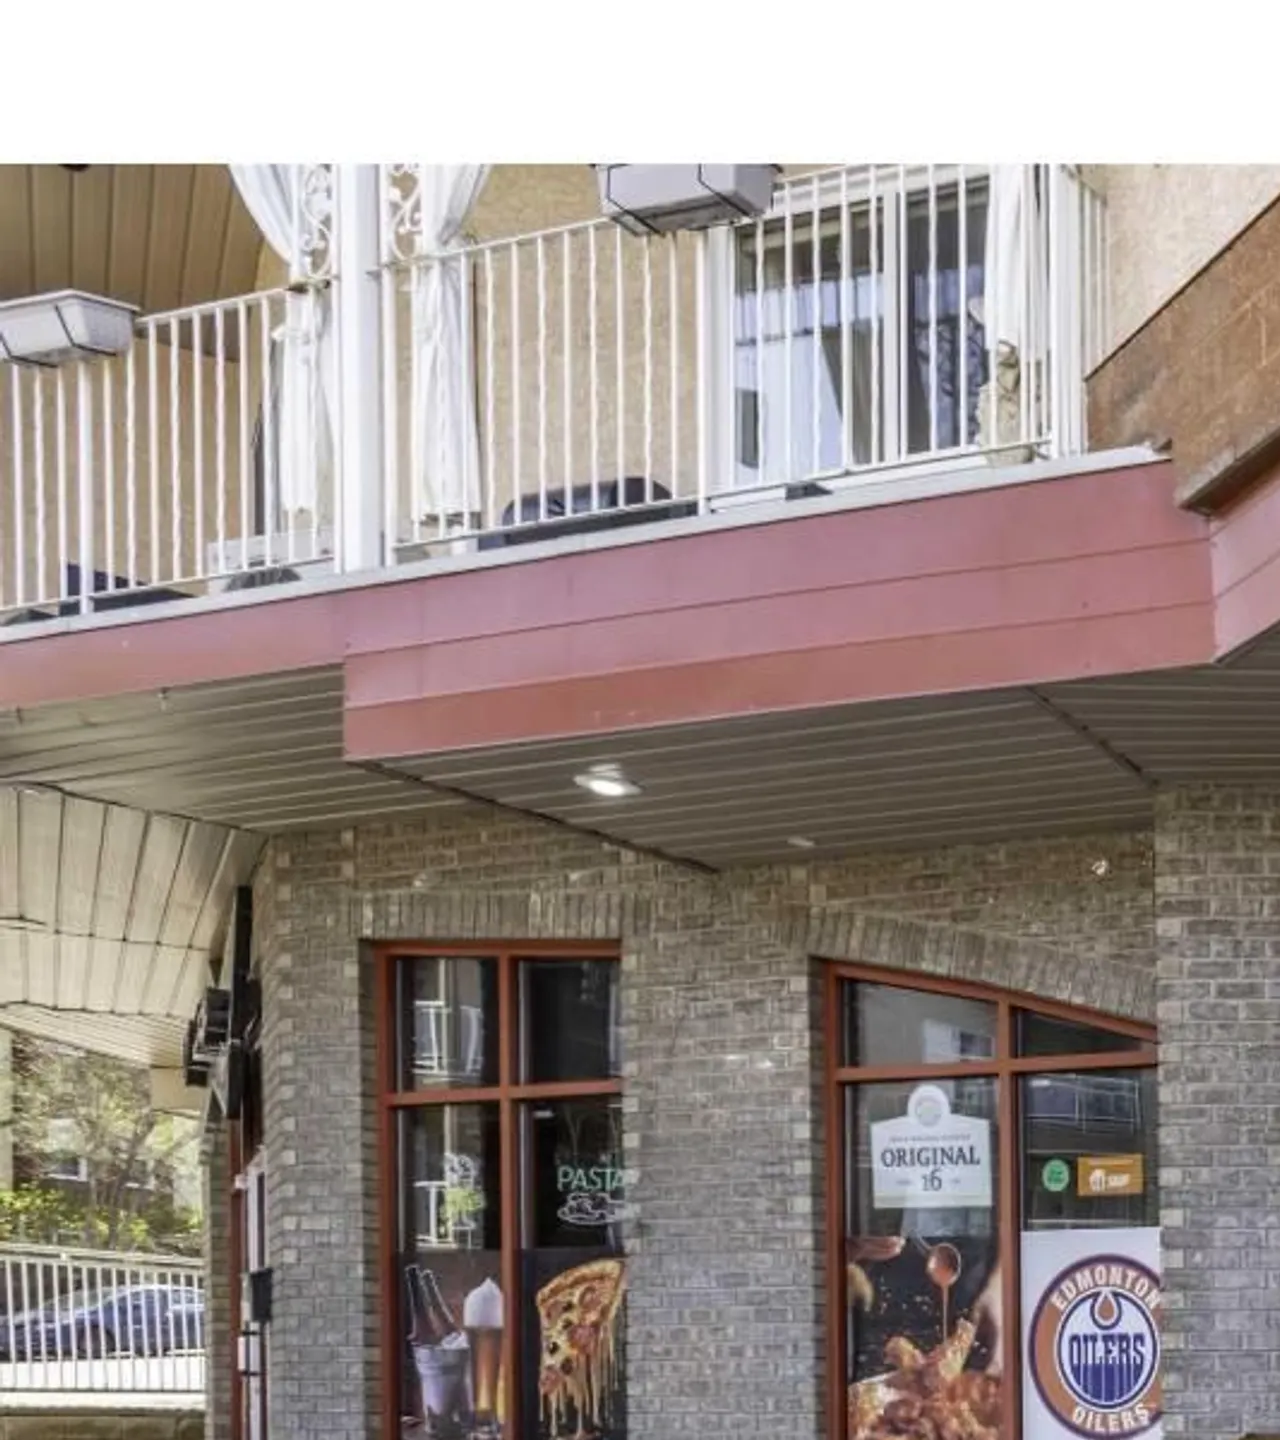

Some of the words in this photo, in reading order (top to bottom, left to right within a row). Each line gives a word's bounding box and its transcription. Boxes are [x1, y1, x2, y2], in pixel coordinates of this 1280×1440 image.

[880, 1144, 981, 1168] ORIGINAL
[921, 1167, 943, 1192] 16
[1068, 1333, 1146, 1402] OILERS
[1072, 1403, 1150, 1433] OILERS
